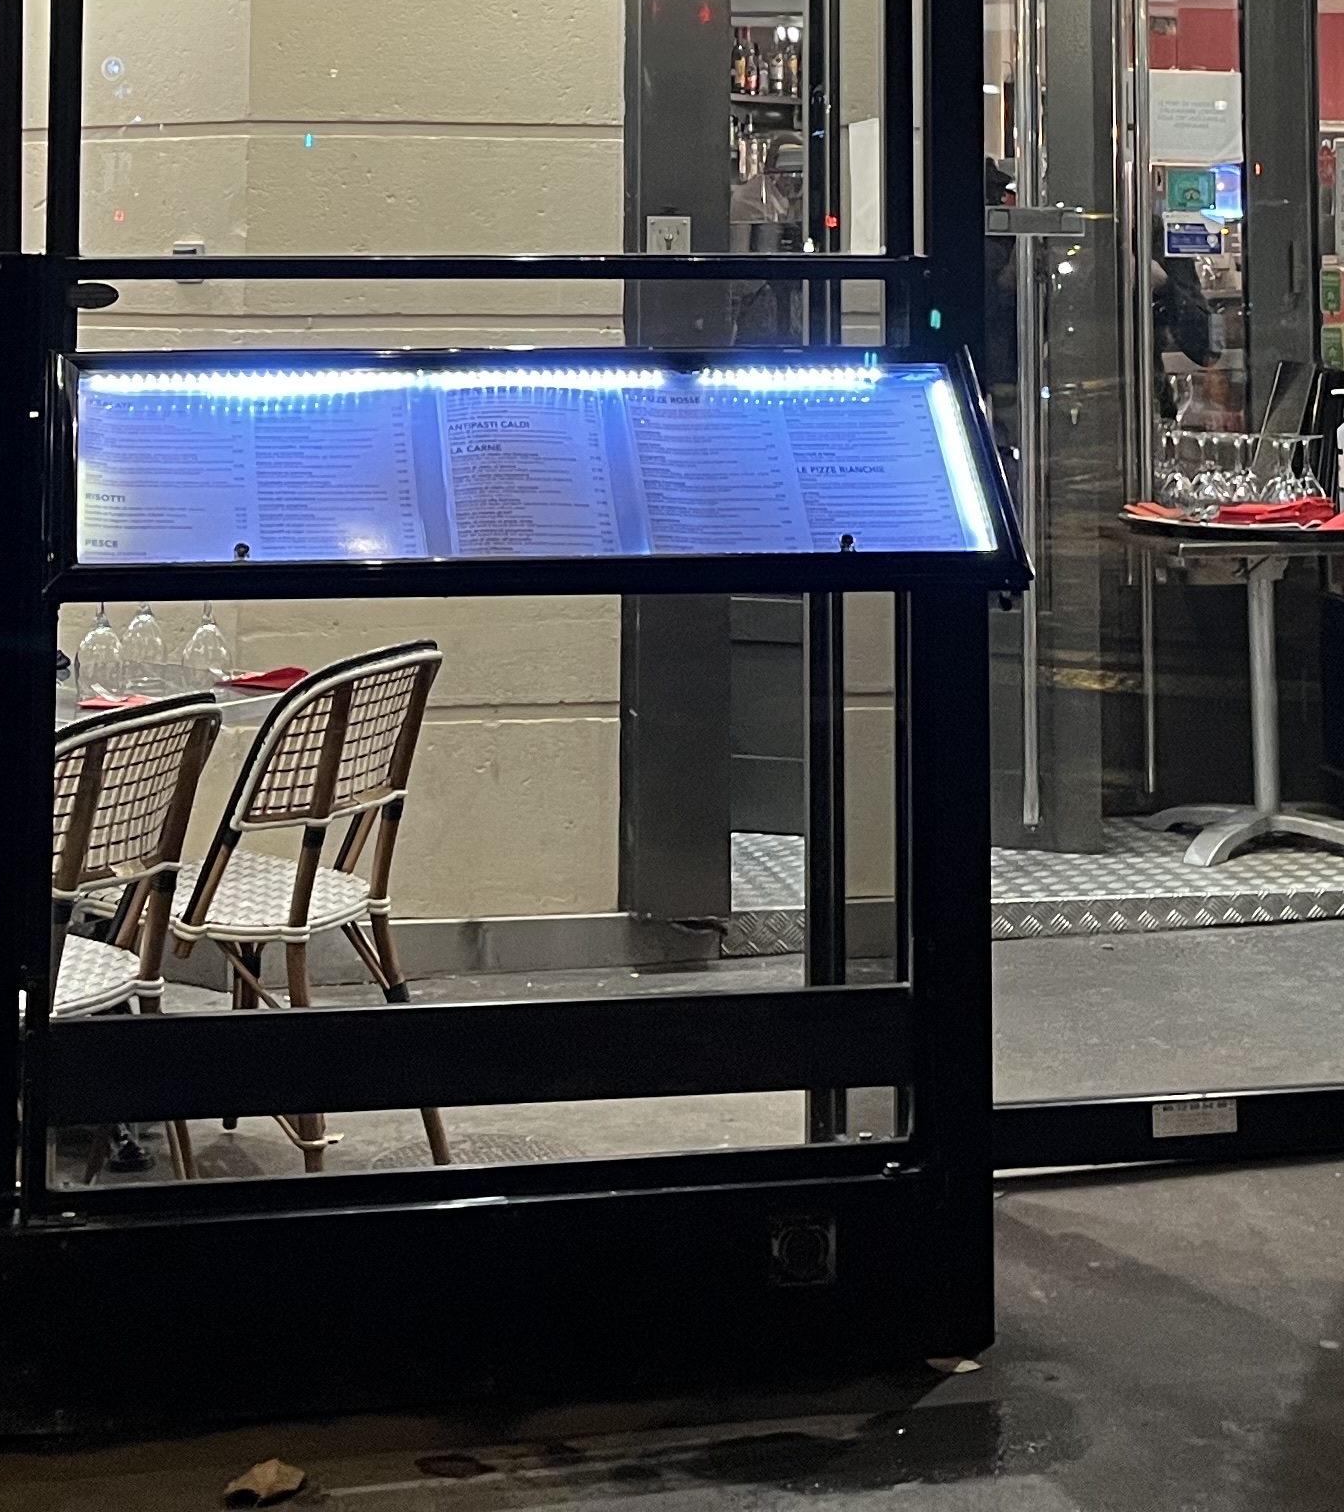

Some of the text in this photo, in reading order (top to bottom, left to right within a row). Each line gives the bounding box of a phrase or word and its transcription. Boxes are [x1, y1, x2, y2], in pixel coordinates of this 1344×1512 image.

[448, 421, 530, 431] ANTIPASTI CALDI
[467, 444, 502, 452] CARNE
[85, 493, 126, 503] RISOTTI
[85, 539, 119, 548] PESCE
